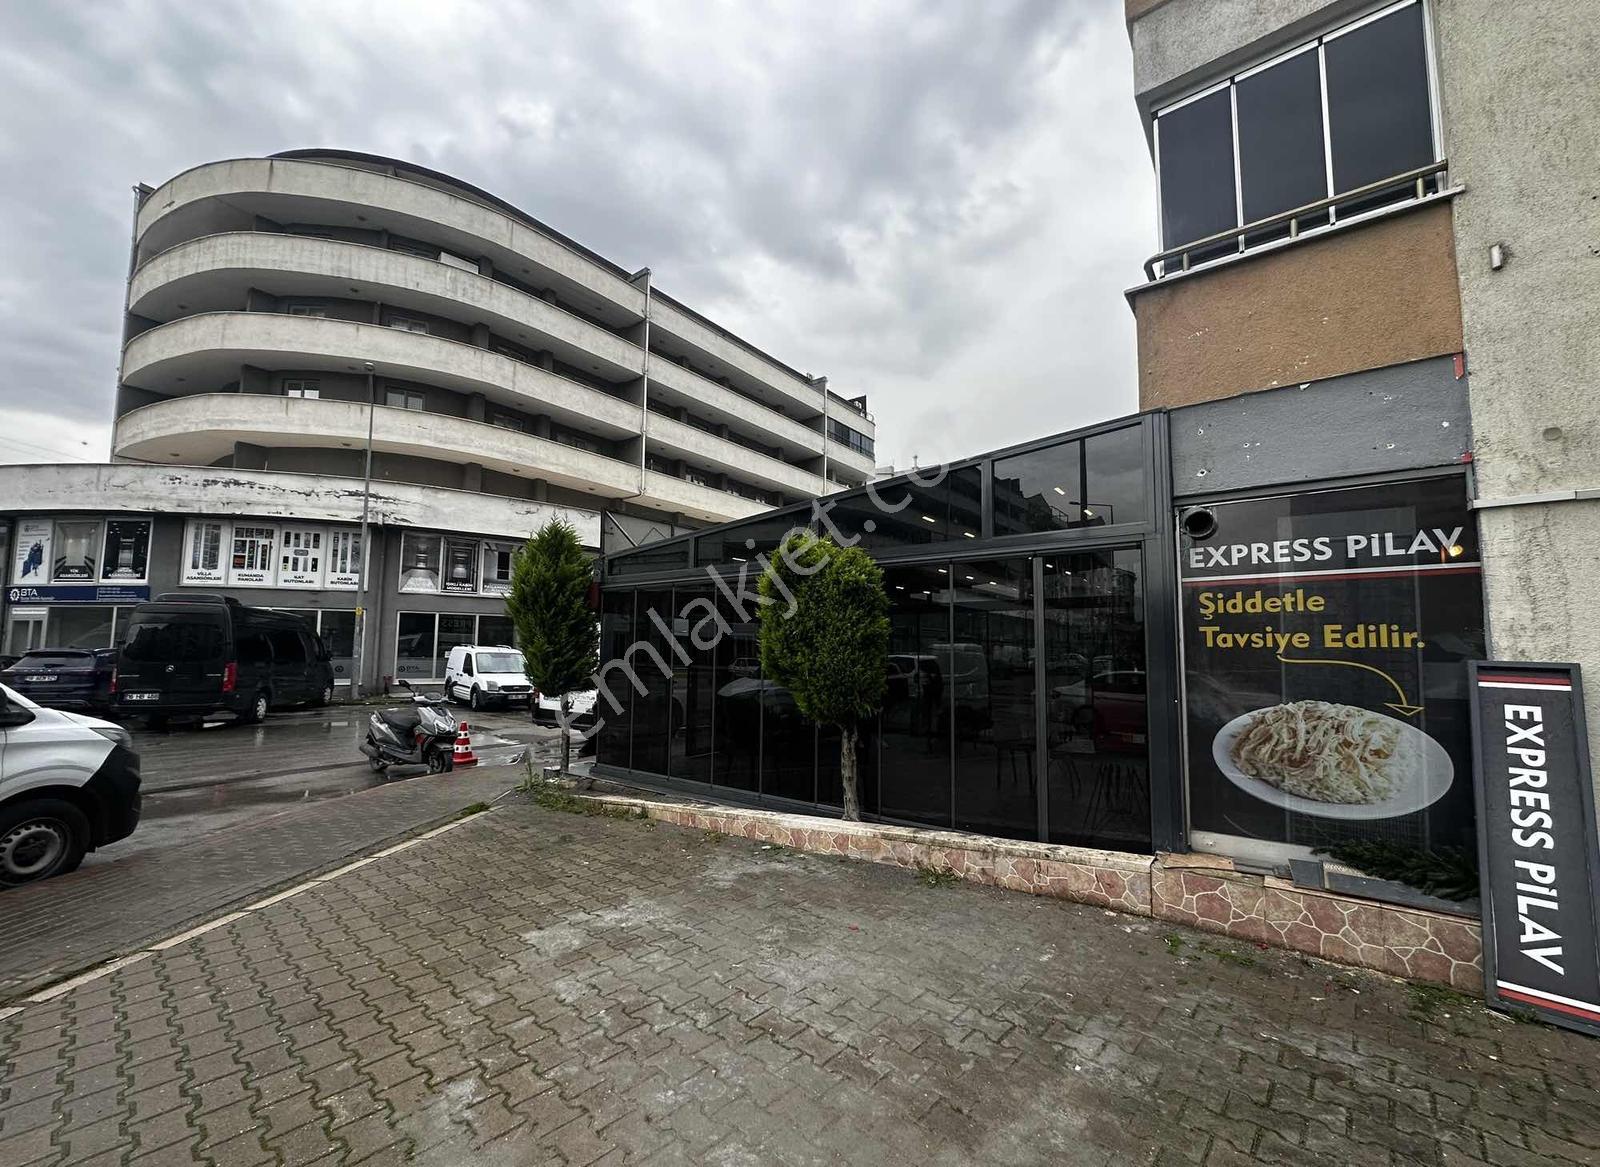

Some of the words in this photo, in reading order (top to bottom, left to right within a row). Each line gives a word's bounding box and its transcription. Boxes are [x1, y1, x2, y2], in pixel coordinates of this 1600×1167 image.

[1189, 537, 1333, 568] EXPRESS
[21, 588, 38, 597] BTA
[1198, 589, 1326, 620] Şiddetle
[1198, 625, 1310, 654] Tavsiye
[1323, 623, 1426, 648] Edilir.
[1503, 703, 1555, 850] EXPRESS
